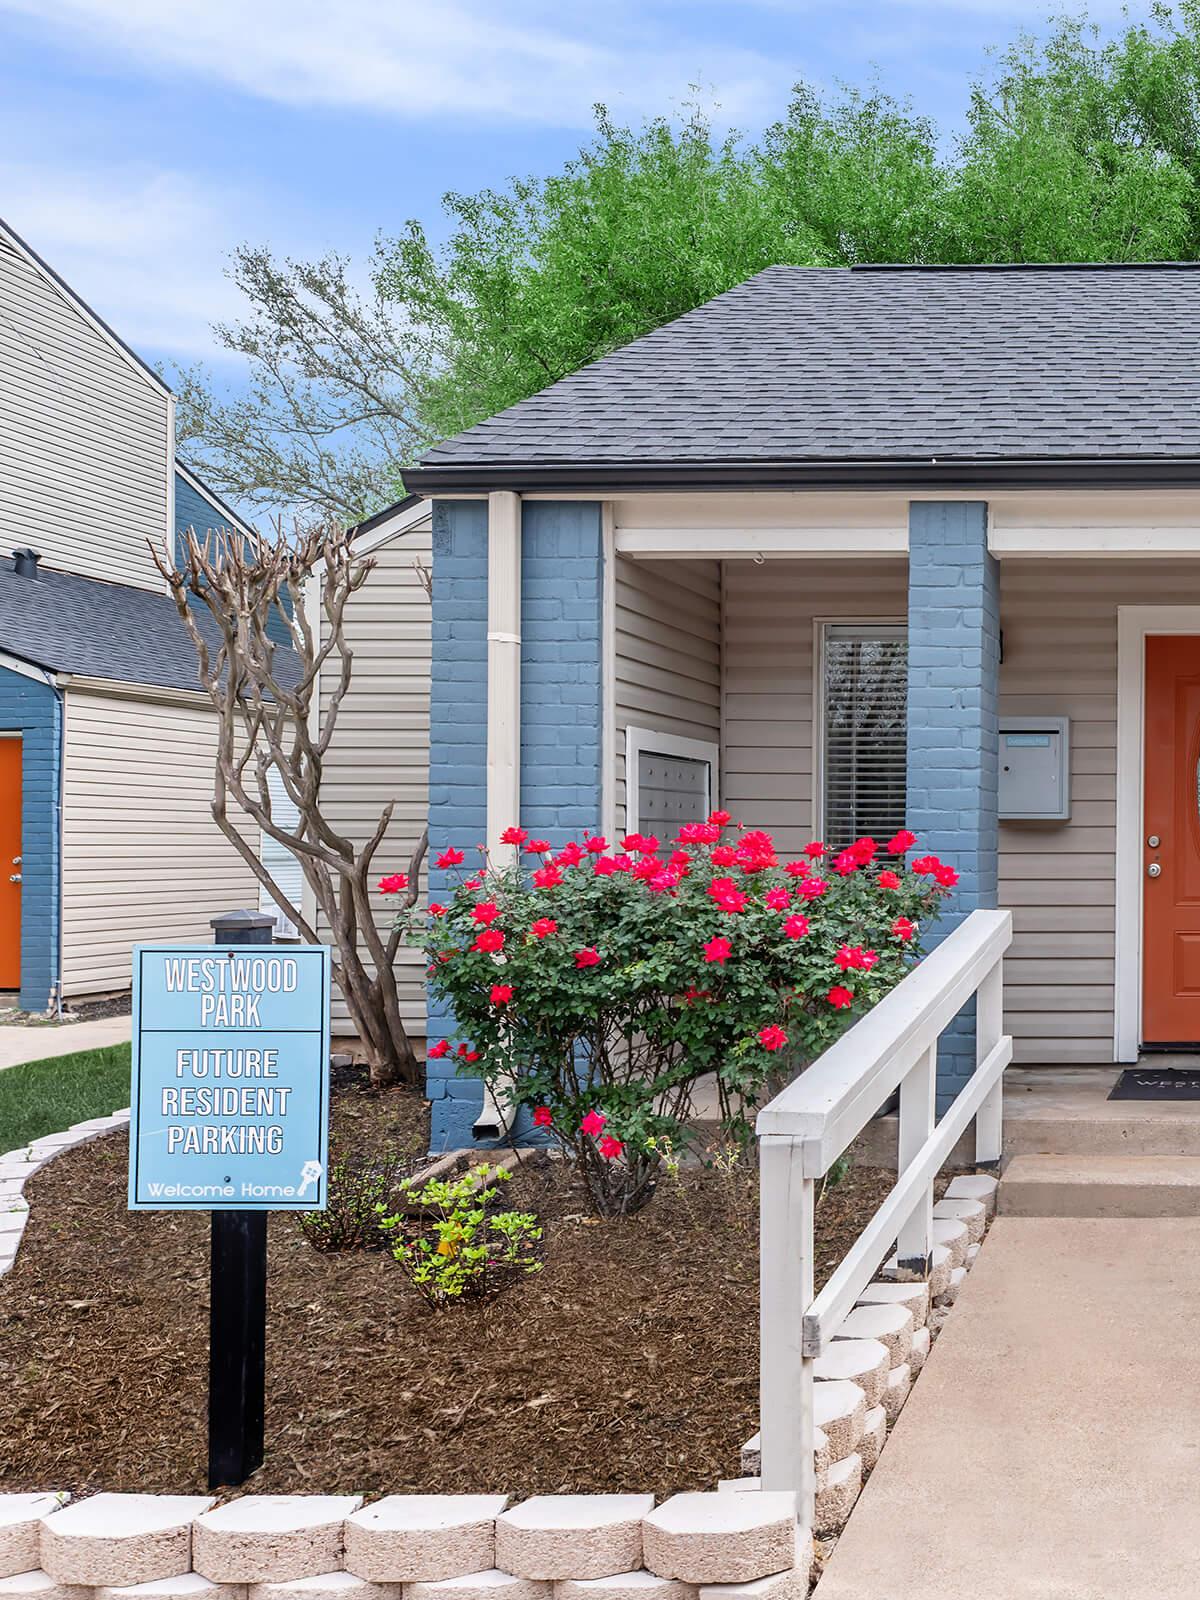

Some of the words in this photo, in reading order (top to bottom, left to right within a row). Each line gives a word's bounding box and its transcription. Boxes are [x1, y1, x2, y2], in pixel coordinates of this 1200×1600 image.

[164, 958, 298, 993] WESTWOOD
[200, 994, 262, 1027] PARK
[175, 1049, 280, 1078] FUTURE
[161, 1087, 292, 1116] RESIDENT
[167, 1125, 284, 1154] PARKING
[147, 1182, 235, 1197] Welcome
[241, 1182, 296, 1197] Home
